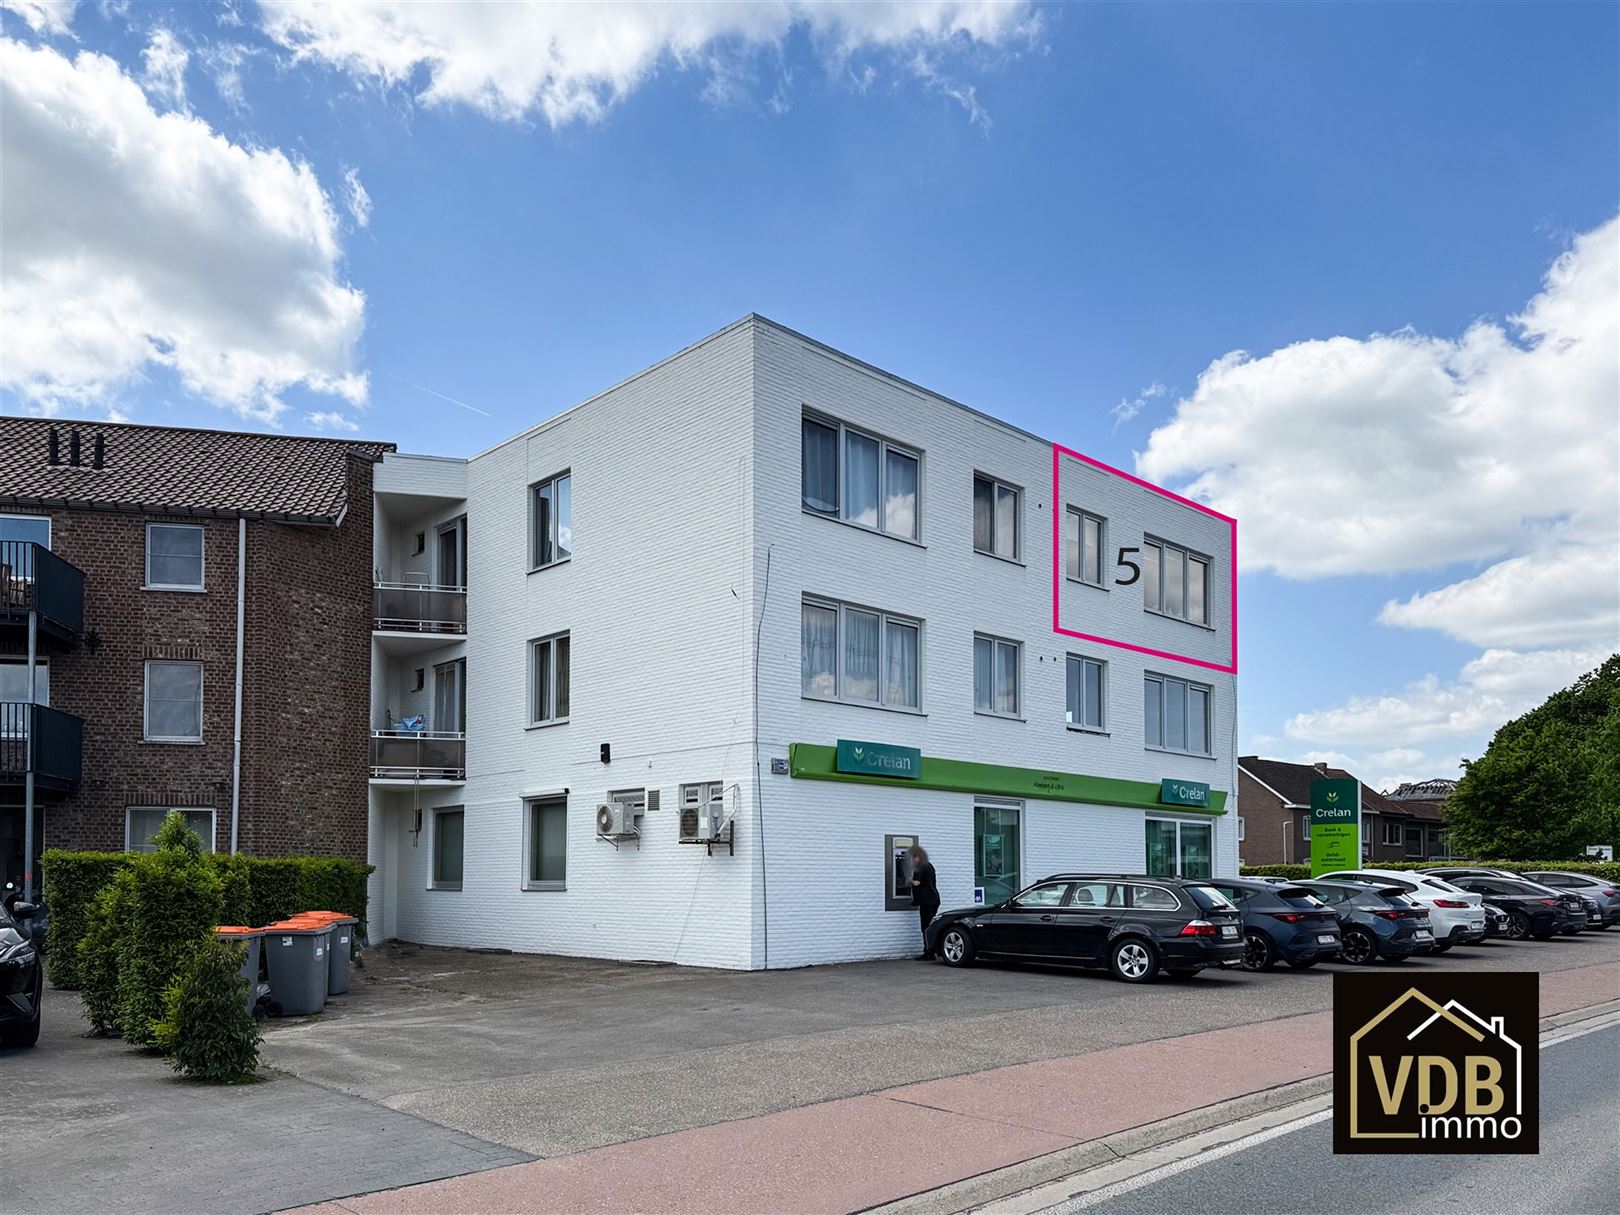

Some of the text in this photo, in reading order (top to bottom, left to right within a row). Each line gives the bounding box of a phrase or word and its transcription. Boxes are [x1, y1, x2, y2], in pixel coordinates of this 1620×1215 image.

[866, 751, 911, 771] Crelan
[1179, 786, 1205, 801] Crelan
[1315, 808, 1352, 818] Crelan
